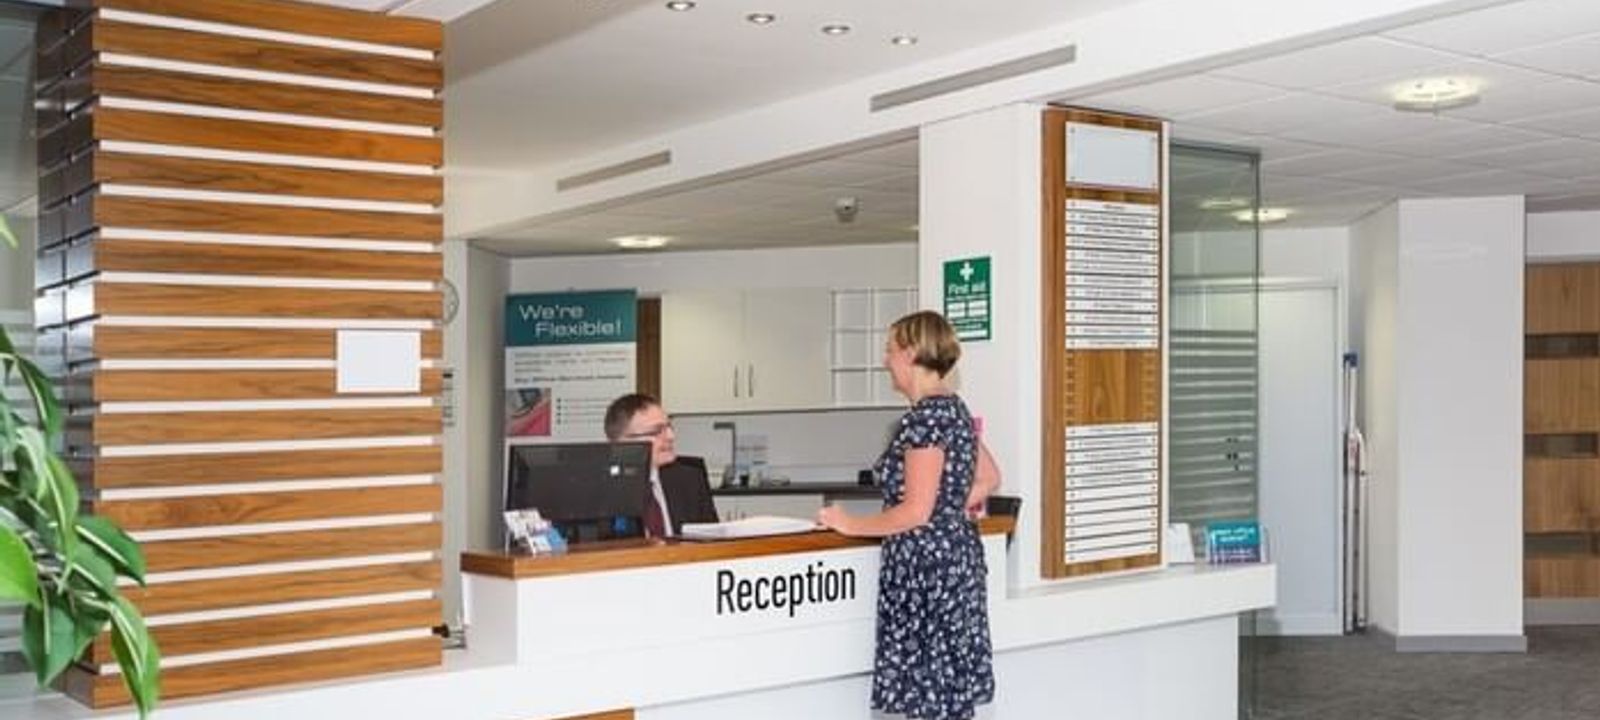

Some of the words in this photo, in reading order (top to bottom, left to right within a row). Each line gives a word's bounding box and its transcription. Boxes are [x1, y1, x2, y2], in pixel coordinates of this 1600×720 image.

[948, 283, 969, 295] First
[518, 304, 585, 321] We're
[534, 319, 622, 339] Flexible!
[716, 561, 856, 618] Reception
